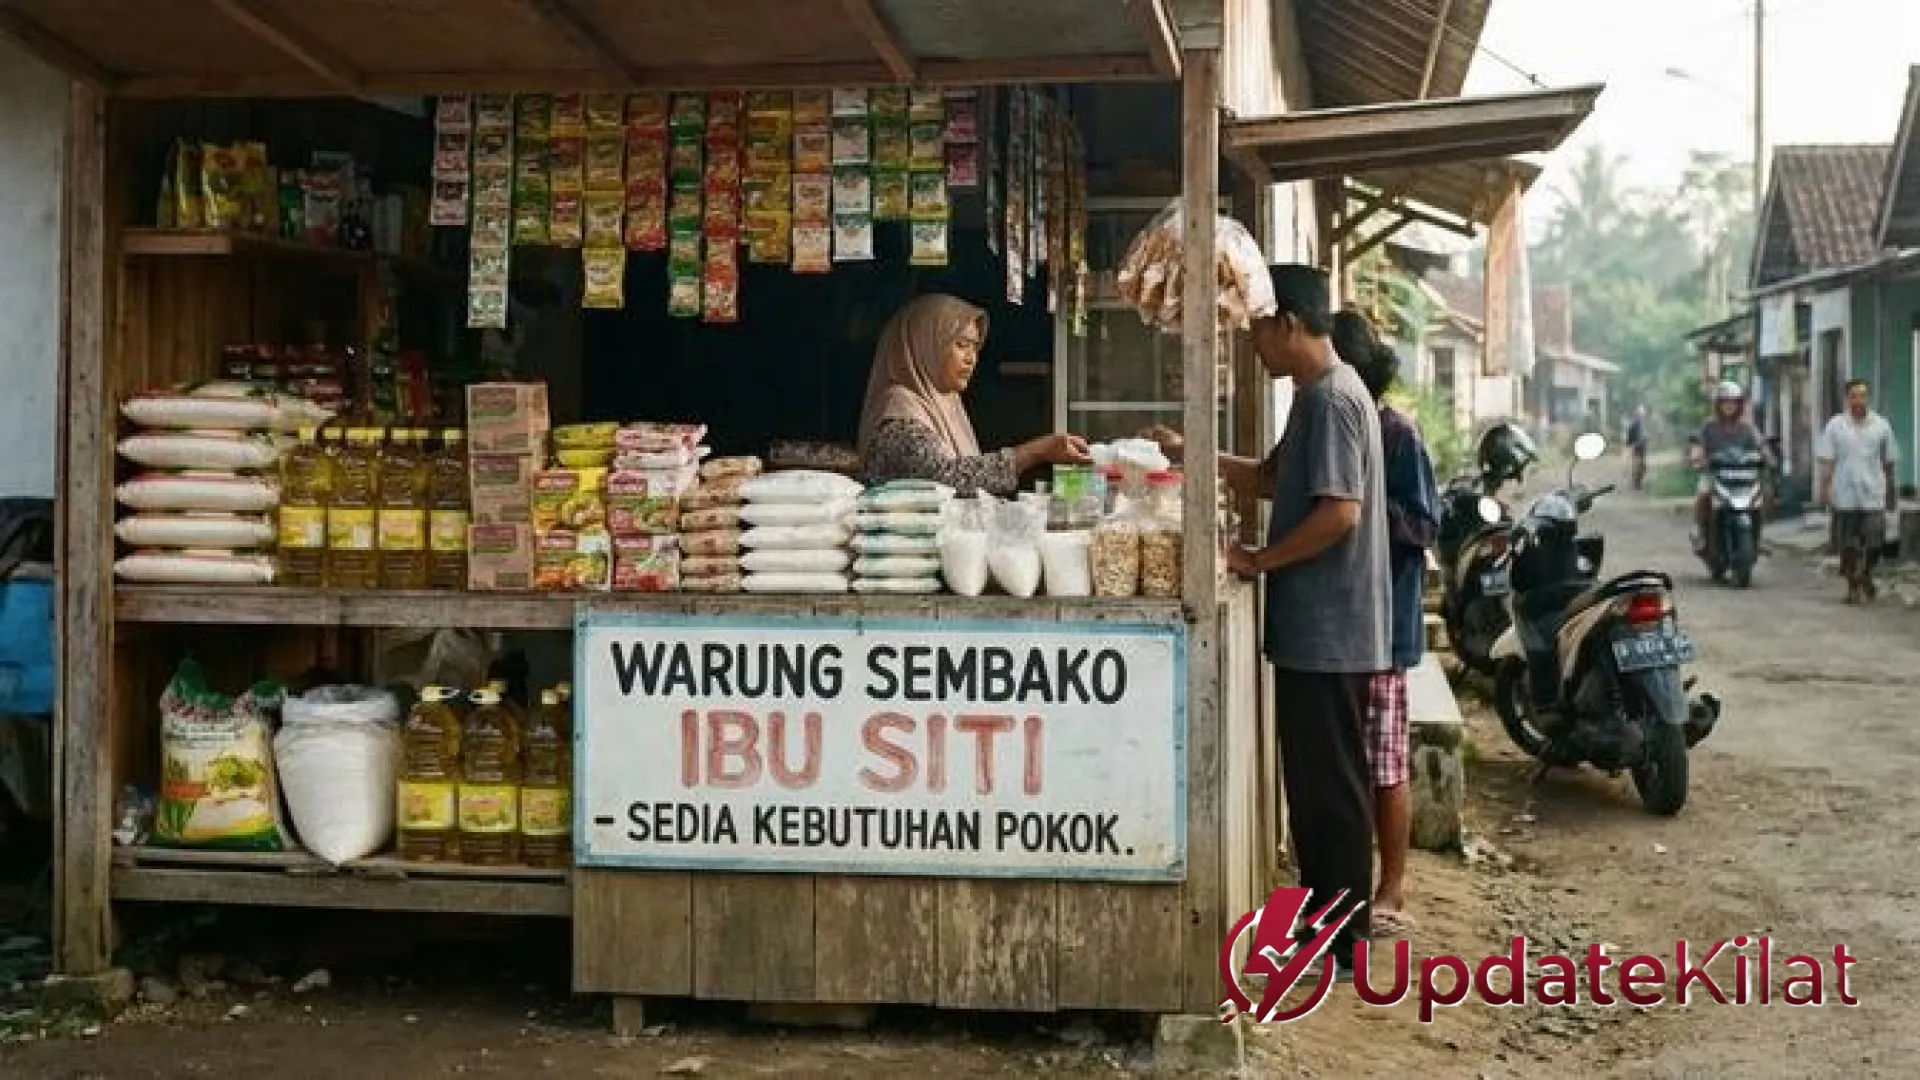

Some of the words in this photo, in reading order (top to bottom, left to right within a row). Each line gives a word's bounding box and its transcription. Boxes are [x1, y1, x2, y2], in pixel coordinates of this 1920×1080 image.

[612, 642, 843, 698] WARUNG
[866, 647, 1127, 704] SEMBAKO
[681, 709, 823, 789] IBU
[859, 712, 1043, 795] SITI
[627, 803, 737, 845] SEDIA
[752, 806, 981, 850] KEBUTUHAN
[999, 812, 1135, 856] POKOK.
